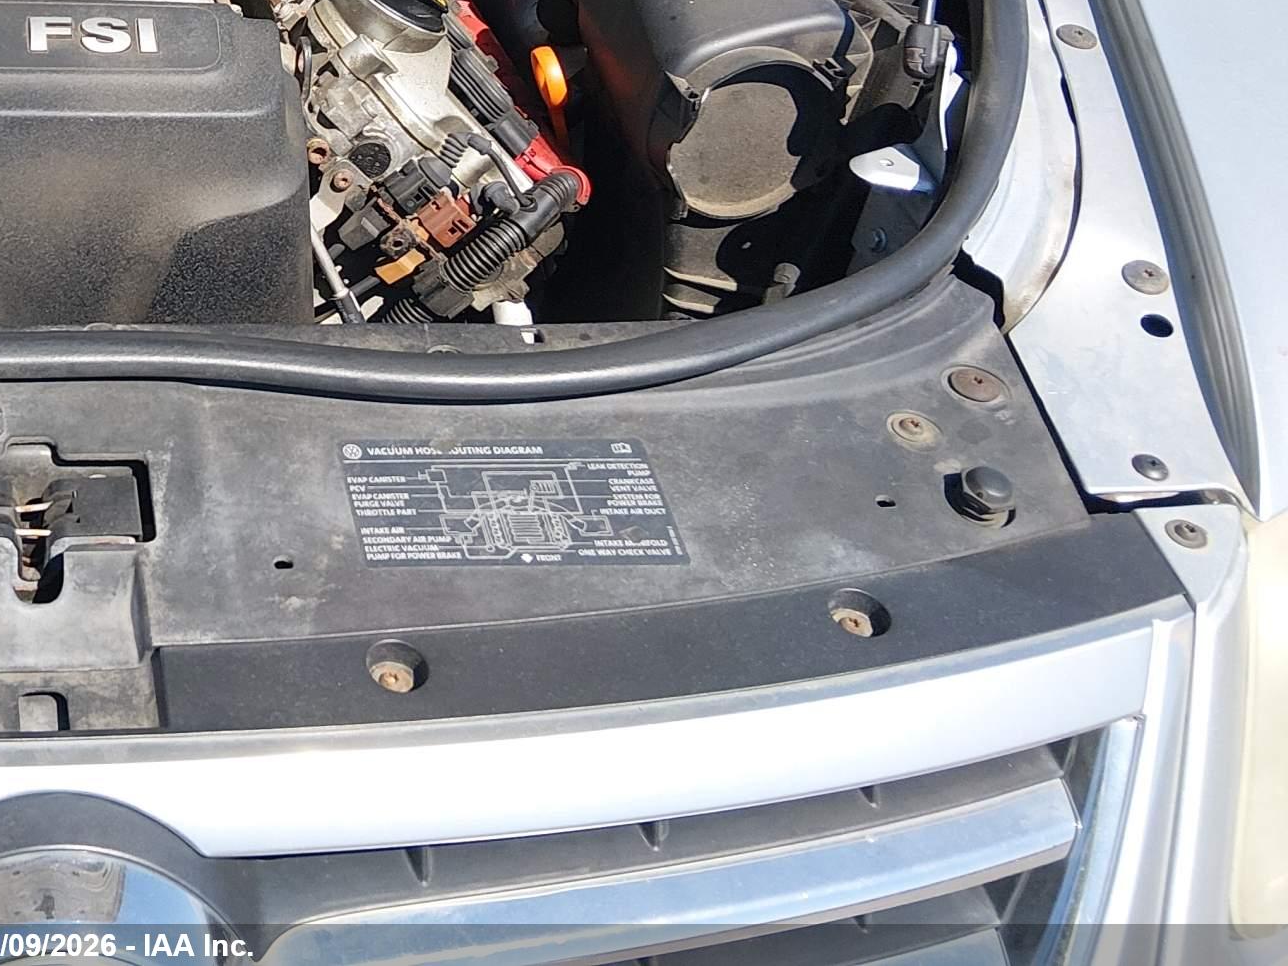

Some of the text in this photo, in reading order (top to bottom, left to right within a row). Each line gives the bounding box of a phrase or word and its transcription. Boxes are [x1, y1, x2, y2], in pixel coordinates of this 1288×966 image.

[27, 16, 158, 53] FSI
[366, 447, 413, 455] VACUUM
[492, 446, 544, 454] DIAGRAM
[368, 475, 406, 483] CANISTER
[352, 492, 410, 500] EVAP CANISTER
[356, 508, 396, 516] THROTTLE
[362, 536, 412, 544] SECONDARY
[593, 539, 624, 547] INTAKE
[366, 552, 390, 560] PUMP
[391, 552, 407, 560] FOR
[437, 551, 463, 559] BRAKE
[577, 547, 672, 556] ONE WAY CHECK VALVE
[535, 554, 562, 562] FRONT
